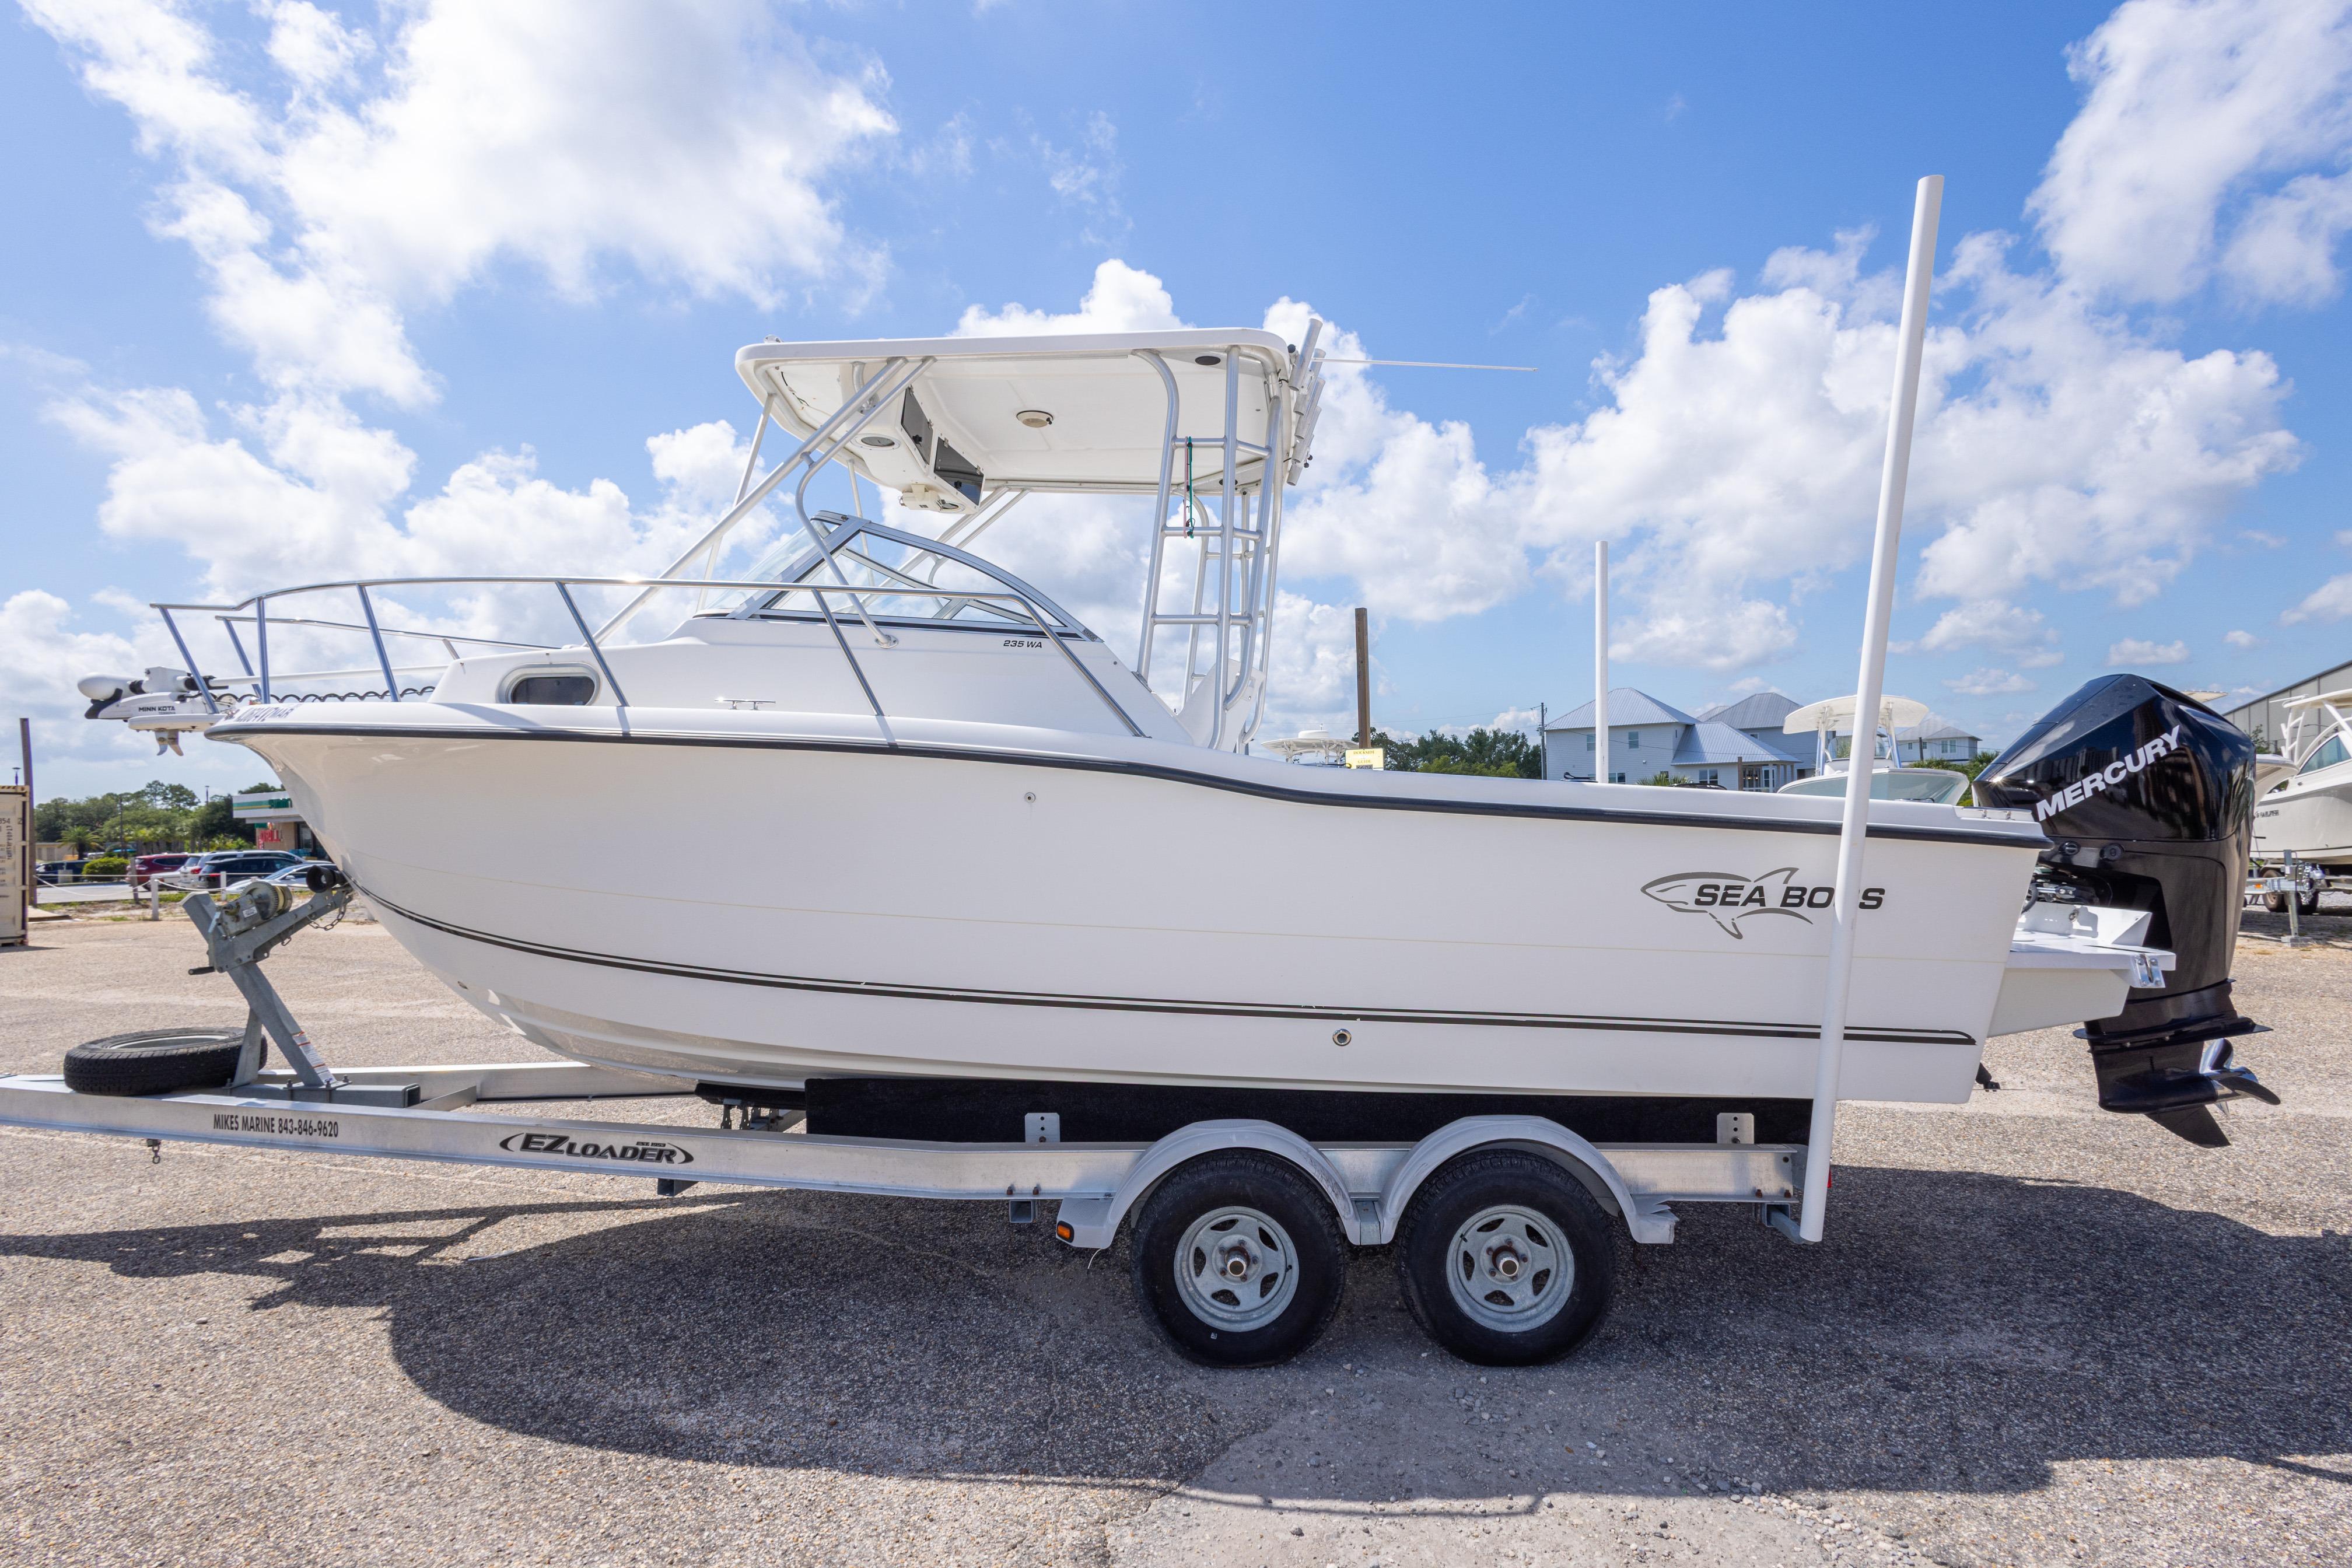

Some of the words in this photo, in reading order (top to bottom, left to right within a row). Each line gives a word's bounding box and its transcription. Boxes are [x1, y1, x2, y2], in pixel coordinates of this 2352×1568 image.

[2036, 725, 2180, 821] MERCURY
[1694, 884, 1766, 907] SEA
[1780, 886, 1885, 909] BOS
[214, 1114, 239, 1131] MIKES
[242, 1115, 275, 1133] MARINE
[278, 1117, 339, 1138] 843-846-9620
